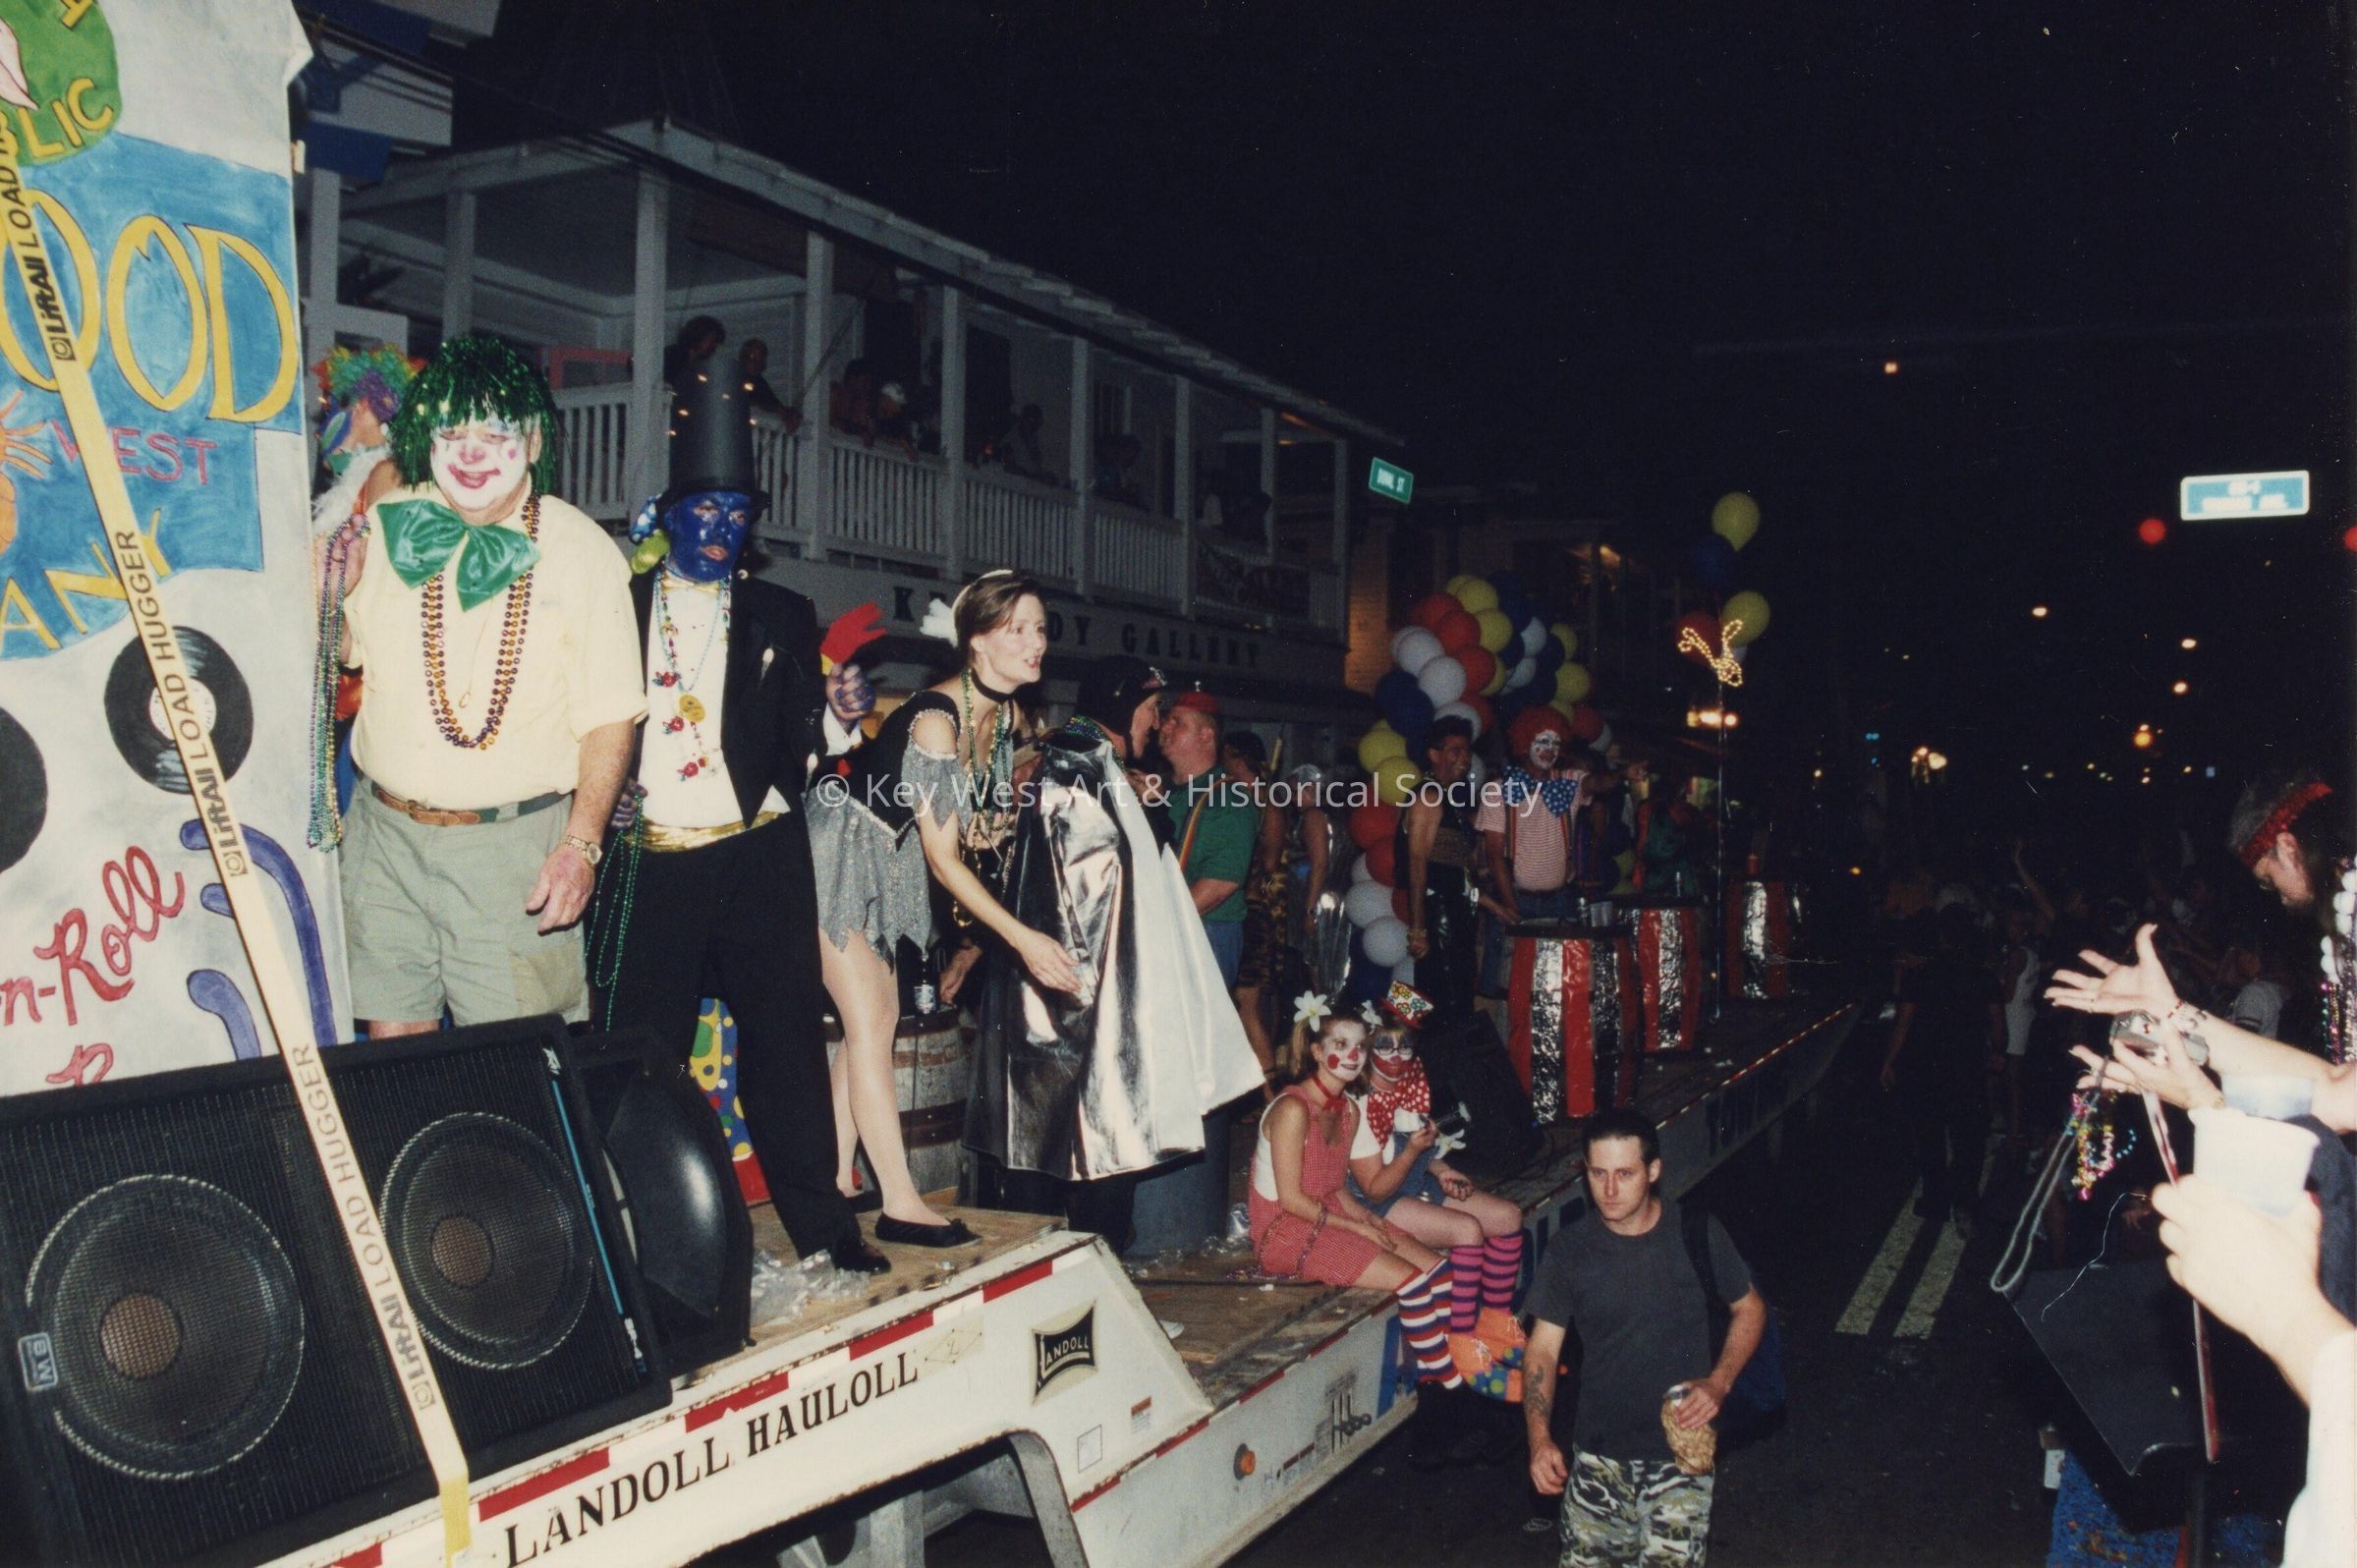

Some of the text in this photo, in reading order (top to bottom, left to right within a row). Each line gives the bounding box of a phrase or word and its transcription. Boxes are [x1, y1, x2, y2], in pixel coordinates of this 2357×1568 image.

[0, 78, 114, 159] LIC
[115, 531, 176, 661] HUGGER
[164, 673, 208, 759] LOAD
[291, 1043, 355, 1183] HUGGER
[345, 1195, 391, 1287] LOAD
[1039, 1333, 1090, 1379] LANDOLL
[504, 1351, 919, 1568] LANDOLL HAULOLL
